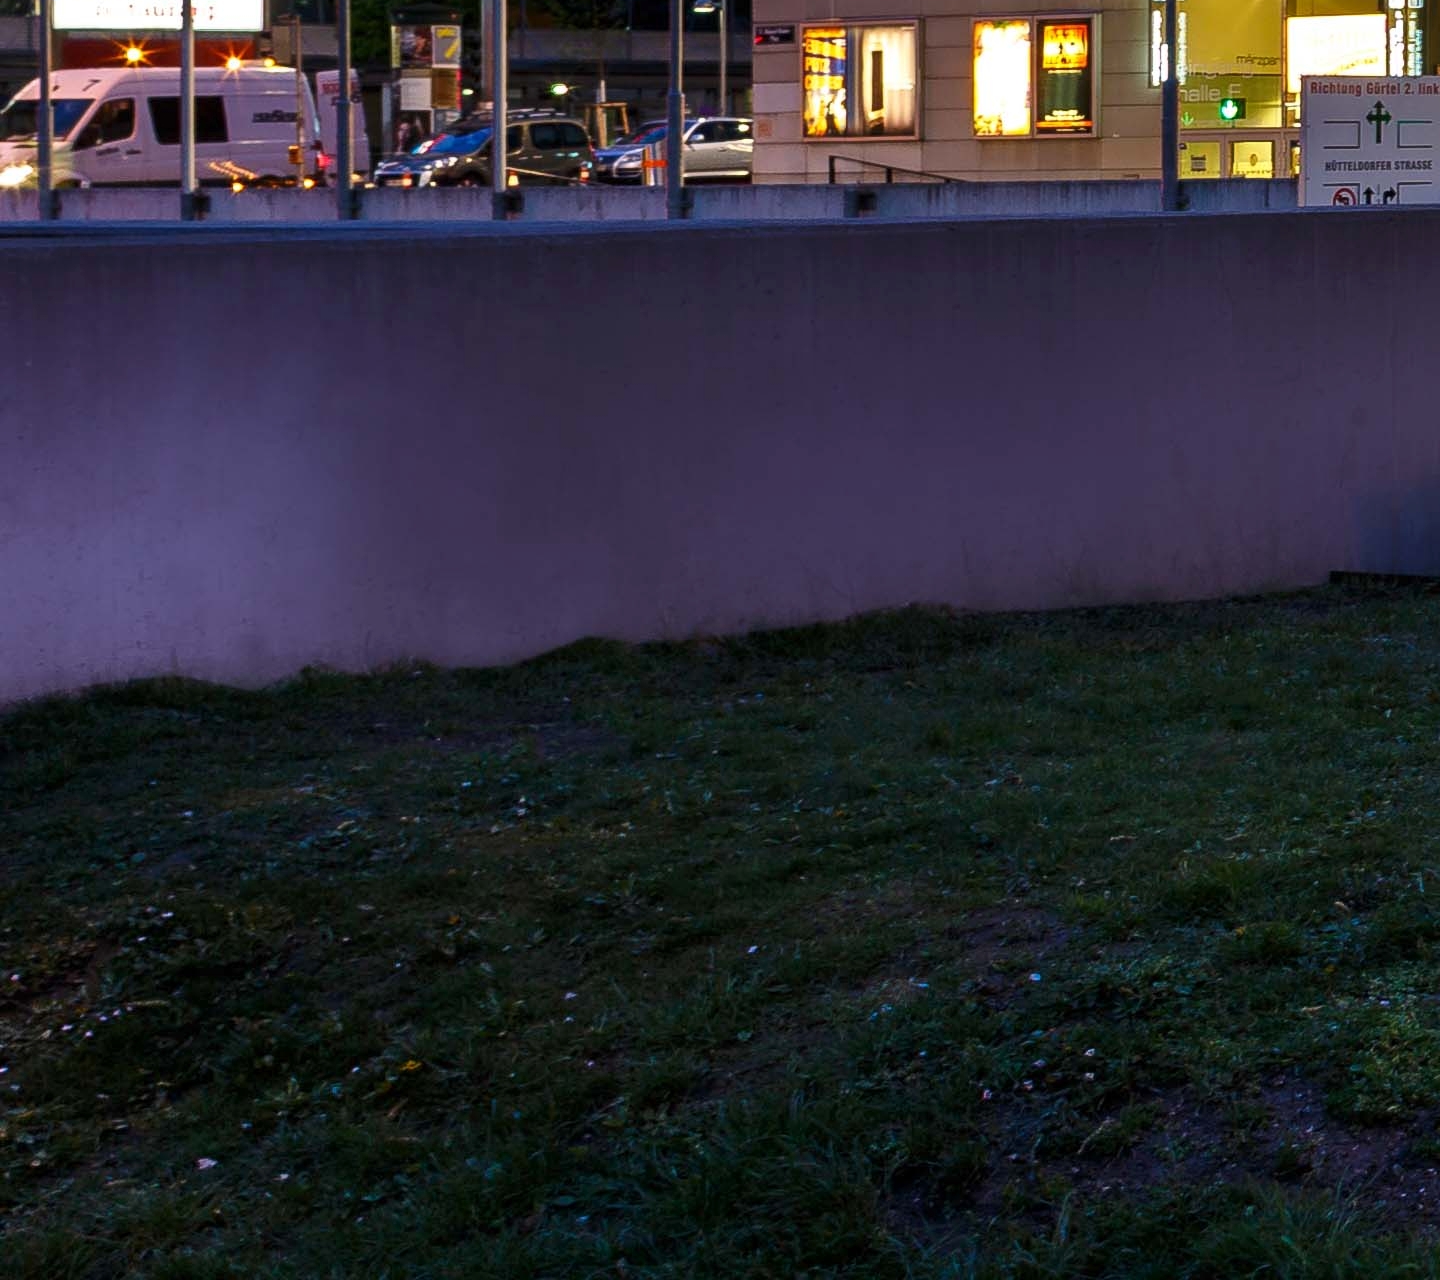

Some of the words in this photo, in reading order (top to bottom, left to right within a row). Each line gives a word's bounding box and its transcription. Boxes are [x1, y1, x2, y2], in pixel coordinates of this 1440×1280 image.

[1236, 54, 1280, 66] märzpar
[1310, 82, 1361, 96] Richtung
[1366, 82, 1400, 95] Gürtel
[1325, 160, 1393, 172] HÜTTELDORFER
[1394, 160, 1432, 171] STRASSE
